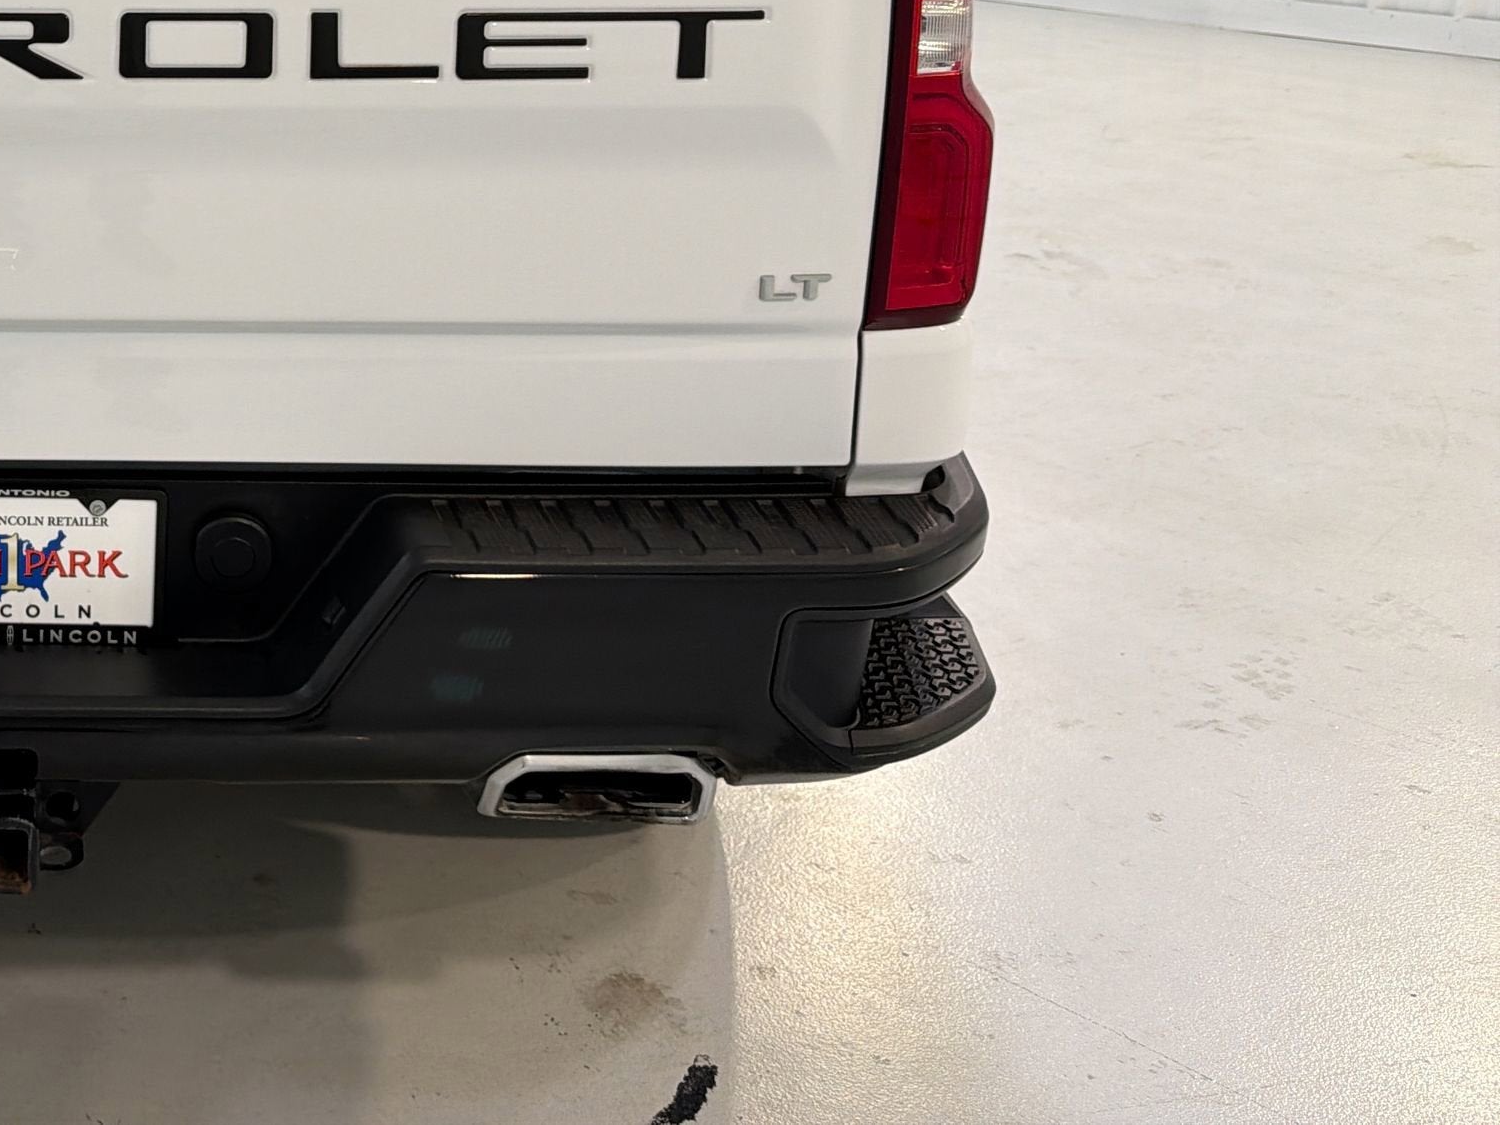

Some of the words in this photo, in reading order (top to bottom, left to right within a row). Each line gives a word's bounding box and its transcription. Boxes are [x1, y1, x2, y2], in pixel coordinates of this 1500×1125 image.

[758, 273, 833, 302] LT
[48, 516, 109, 527] RETAILER
[24, 549, 129, 578] PARK
[23, 629, 138, 645] LINCOLN
